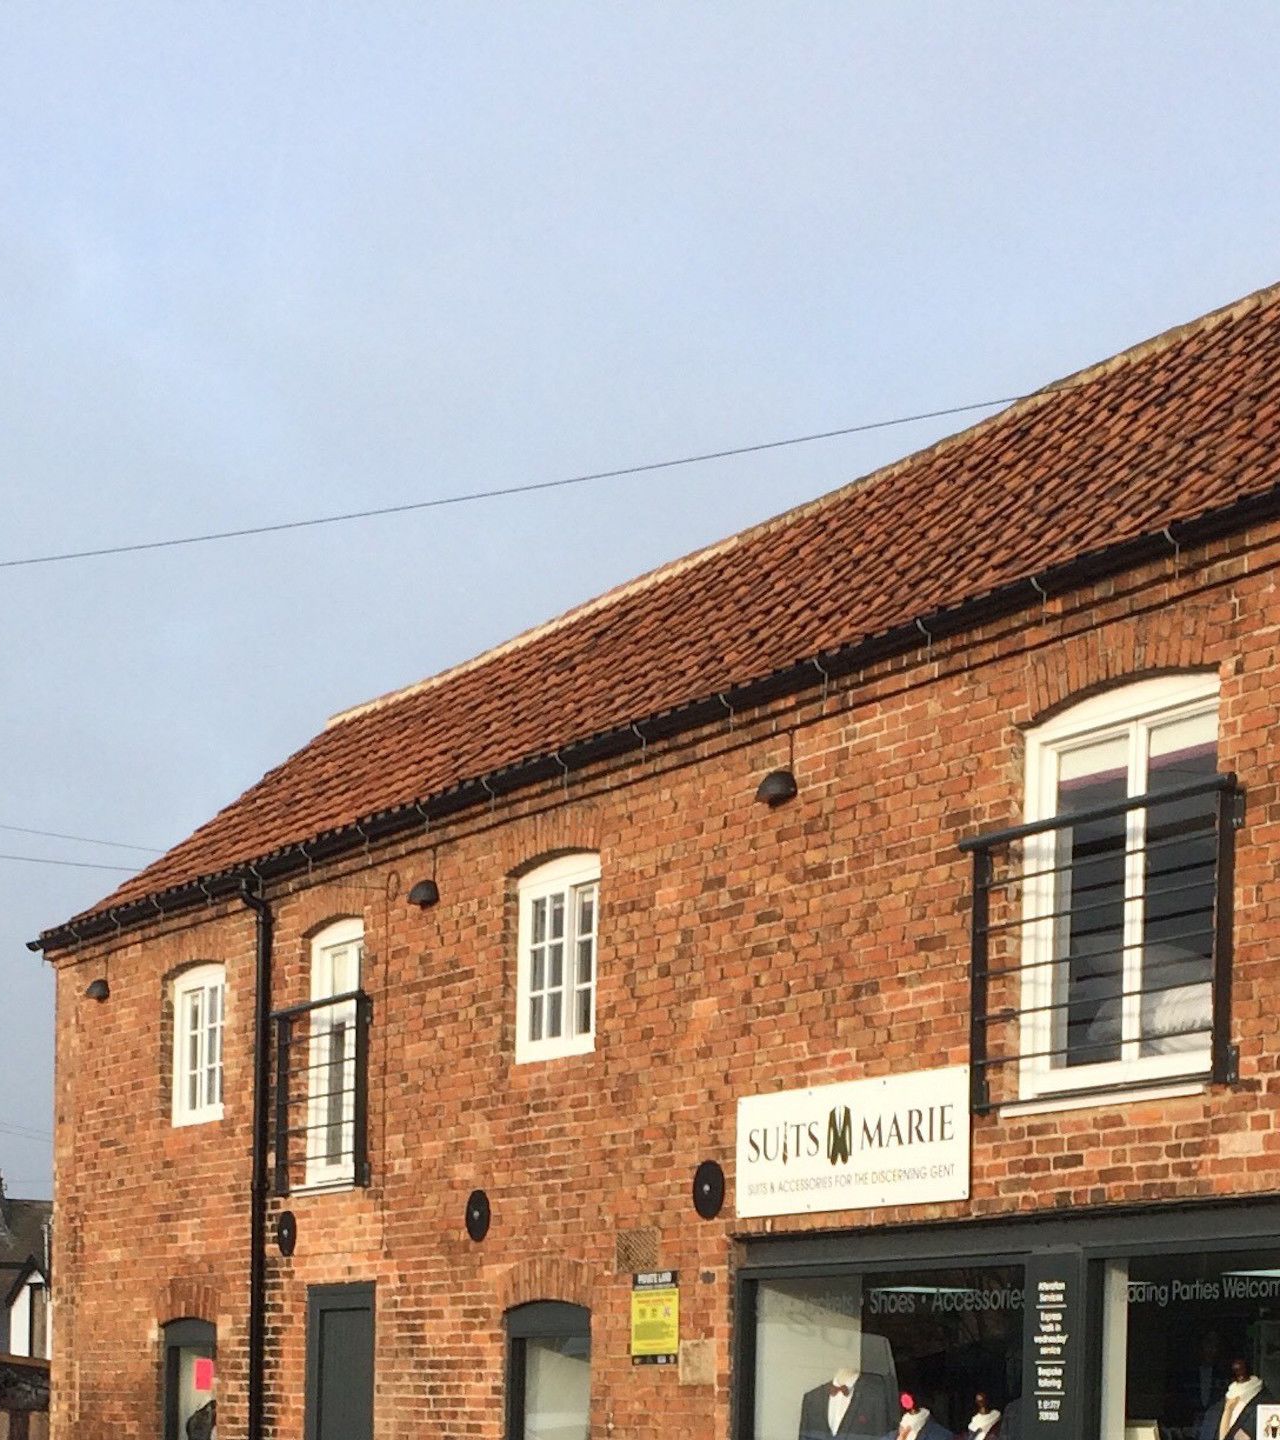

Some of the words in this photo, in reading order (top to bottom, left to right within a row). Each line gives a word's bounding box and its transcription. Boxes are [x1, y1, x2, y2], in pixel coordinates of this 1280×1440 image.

[747, 1121, 820, 1166] SUITS
[860, 1104, 955, 1150] MARIE
[747, 1183, 768, 1196] SUITS
[778, 1176, 833, 1193] ACCESSORIES
[835, 1174, 852, 1187] FOR
[854, 1172, 869, 1185] THE
[871, 1166, 928, 1185] DISCERNING
[930, 1163, 956, 1179] GENT
[870, 1290, 914, 1314] Shoes
[1172, 1279, 1219, 1301] Parties
